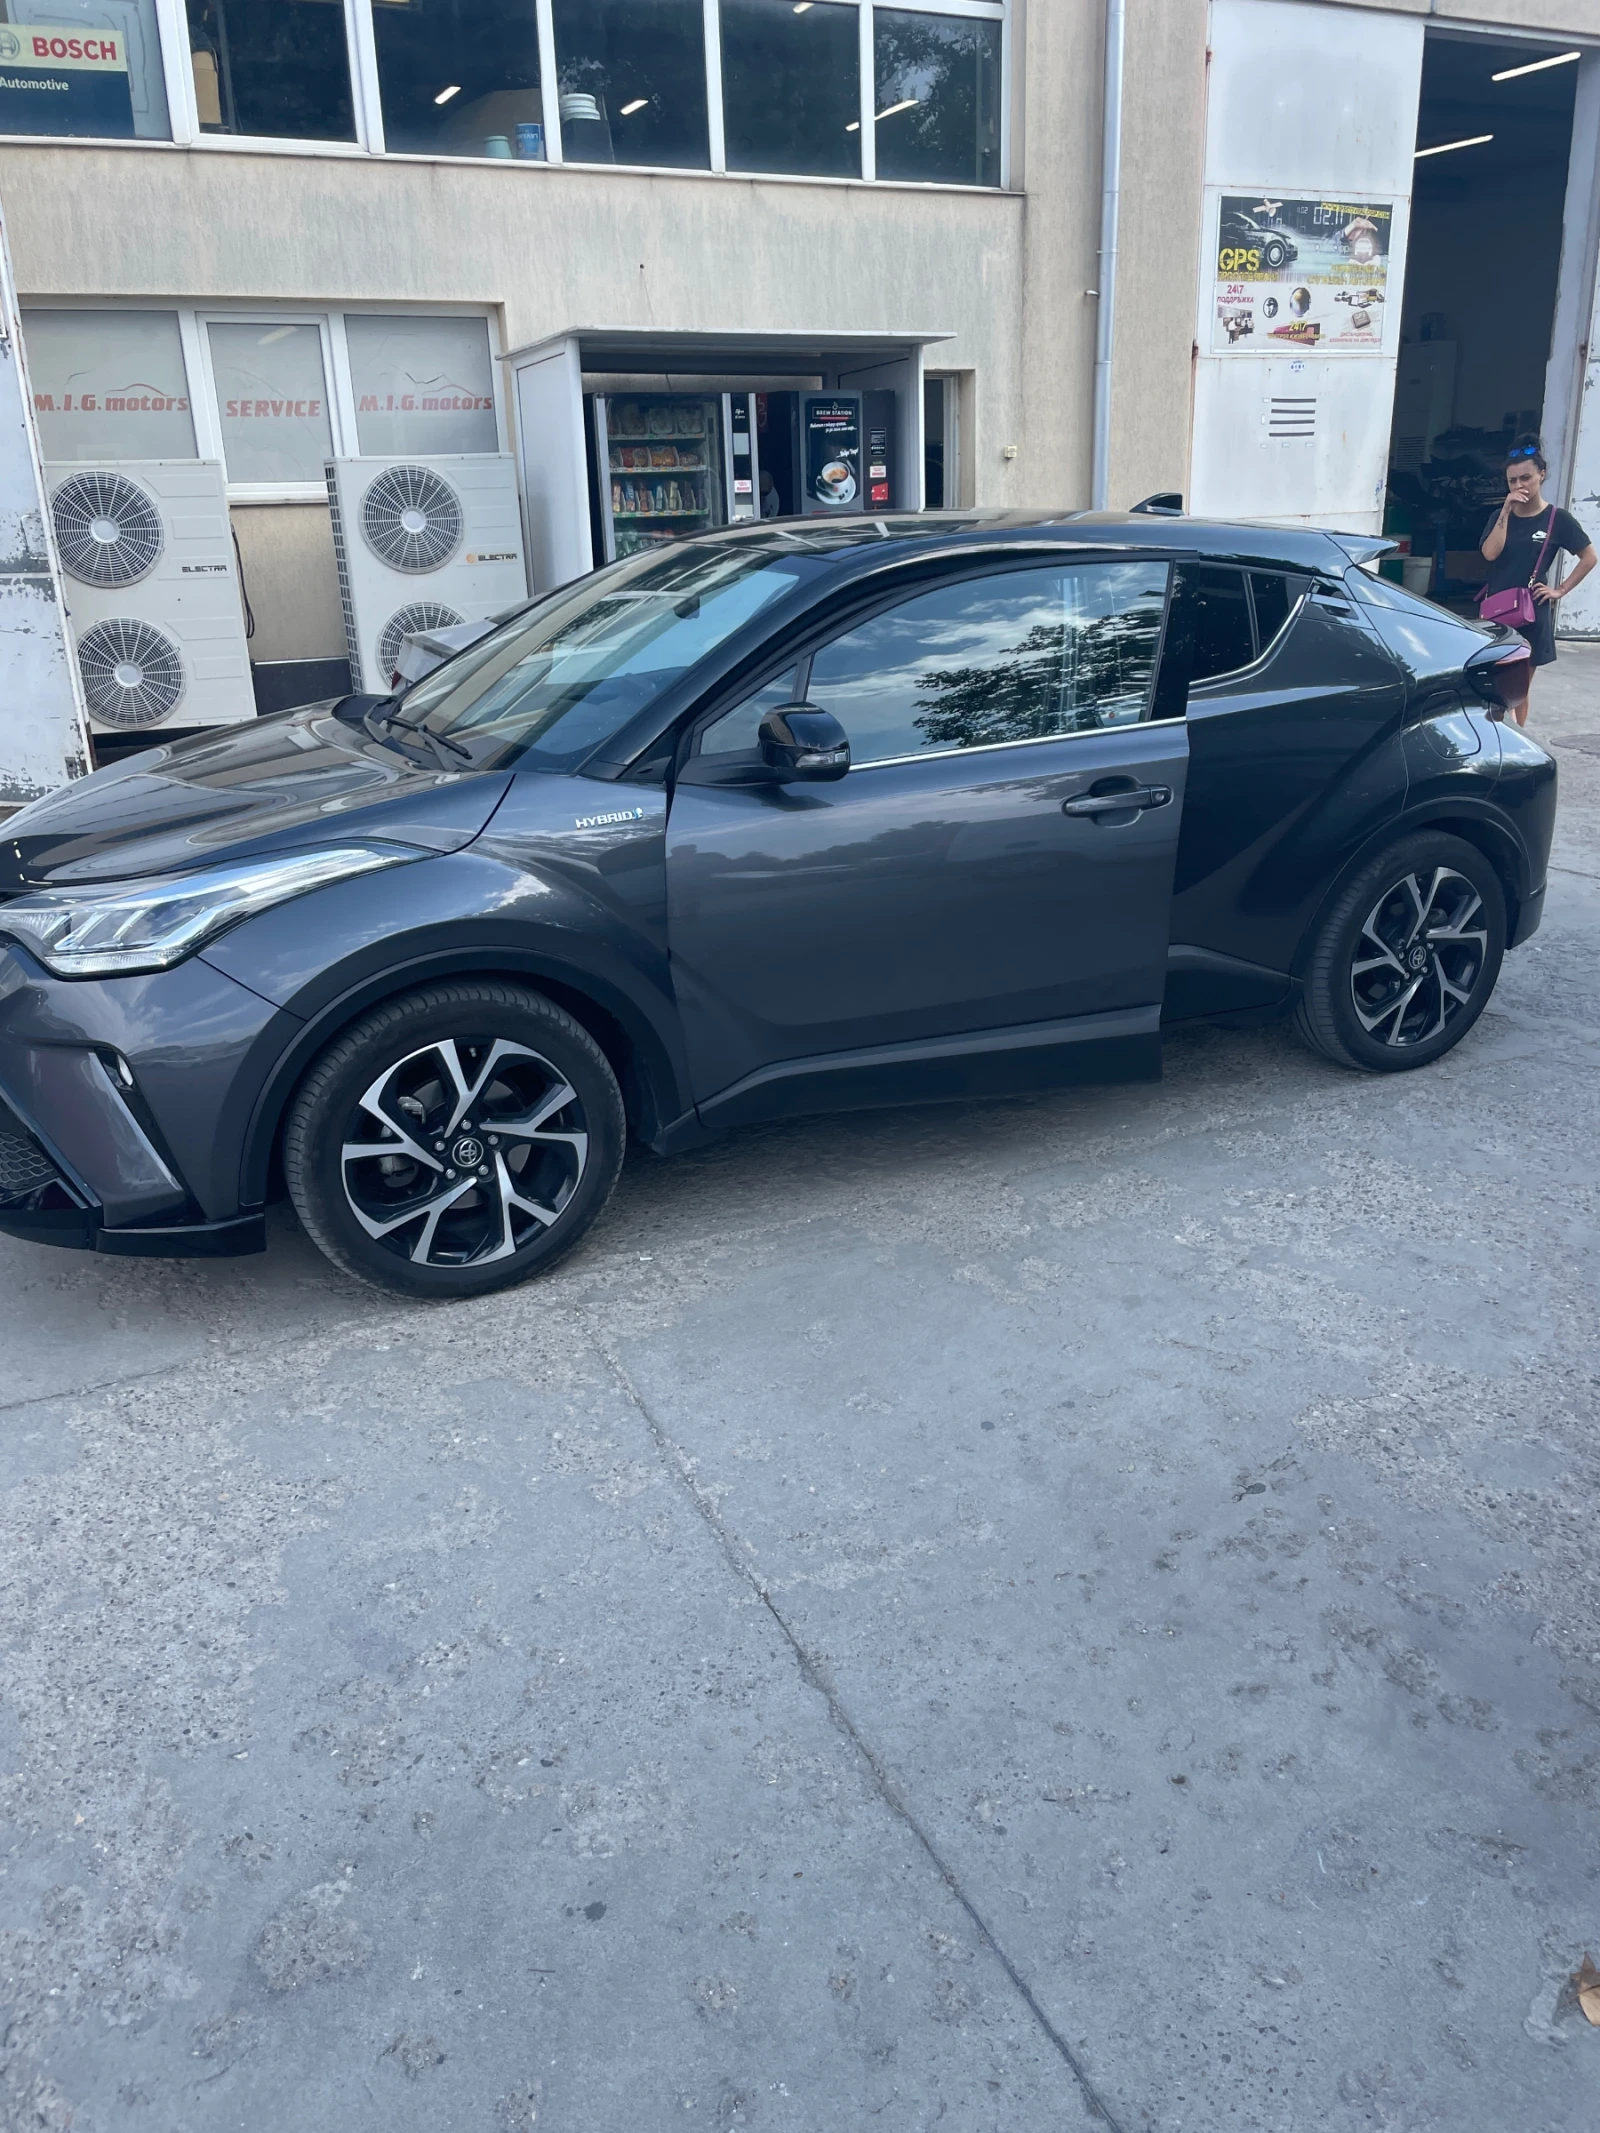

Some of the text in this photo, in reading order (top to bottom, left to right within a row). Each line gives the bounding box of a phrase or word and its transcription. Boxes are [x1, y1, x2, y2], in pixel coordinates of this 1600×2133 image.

[32, 36, 117, 61] BOSCH
[0, 76, 69, 91] Automotive
[1219, 248, 1260, 271] GPS
[1217, 296, 1254, 304] ПОДДРЪЖКА
[225, 400, 321, 417] SERVICE
[477, 553, 518, 561] ELECTRA
[181, 564, 227, 573] ELECTRA
[575, 811, 634, 829] HYBRID
